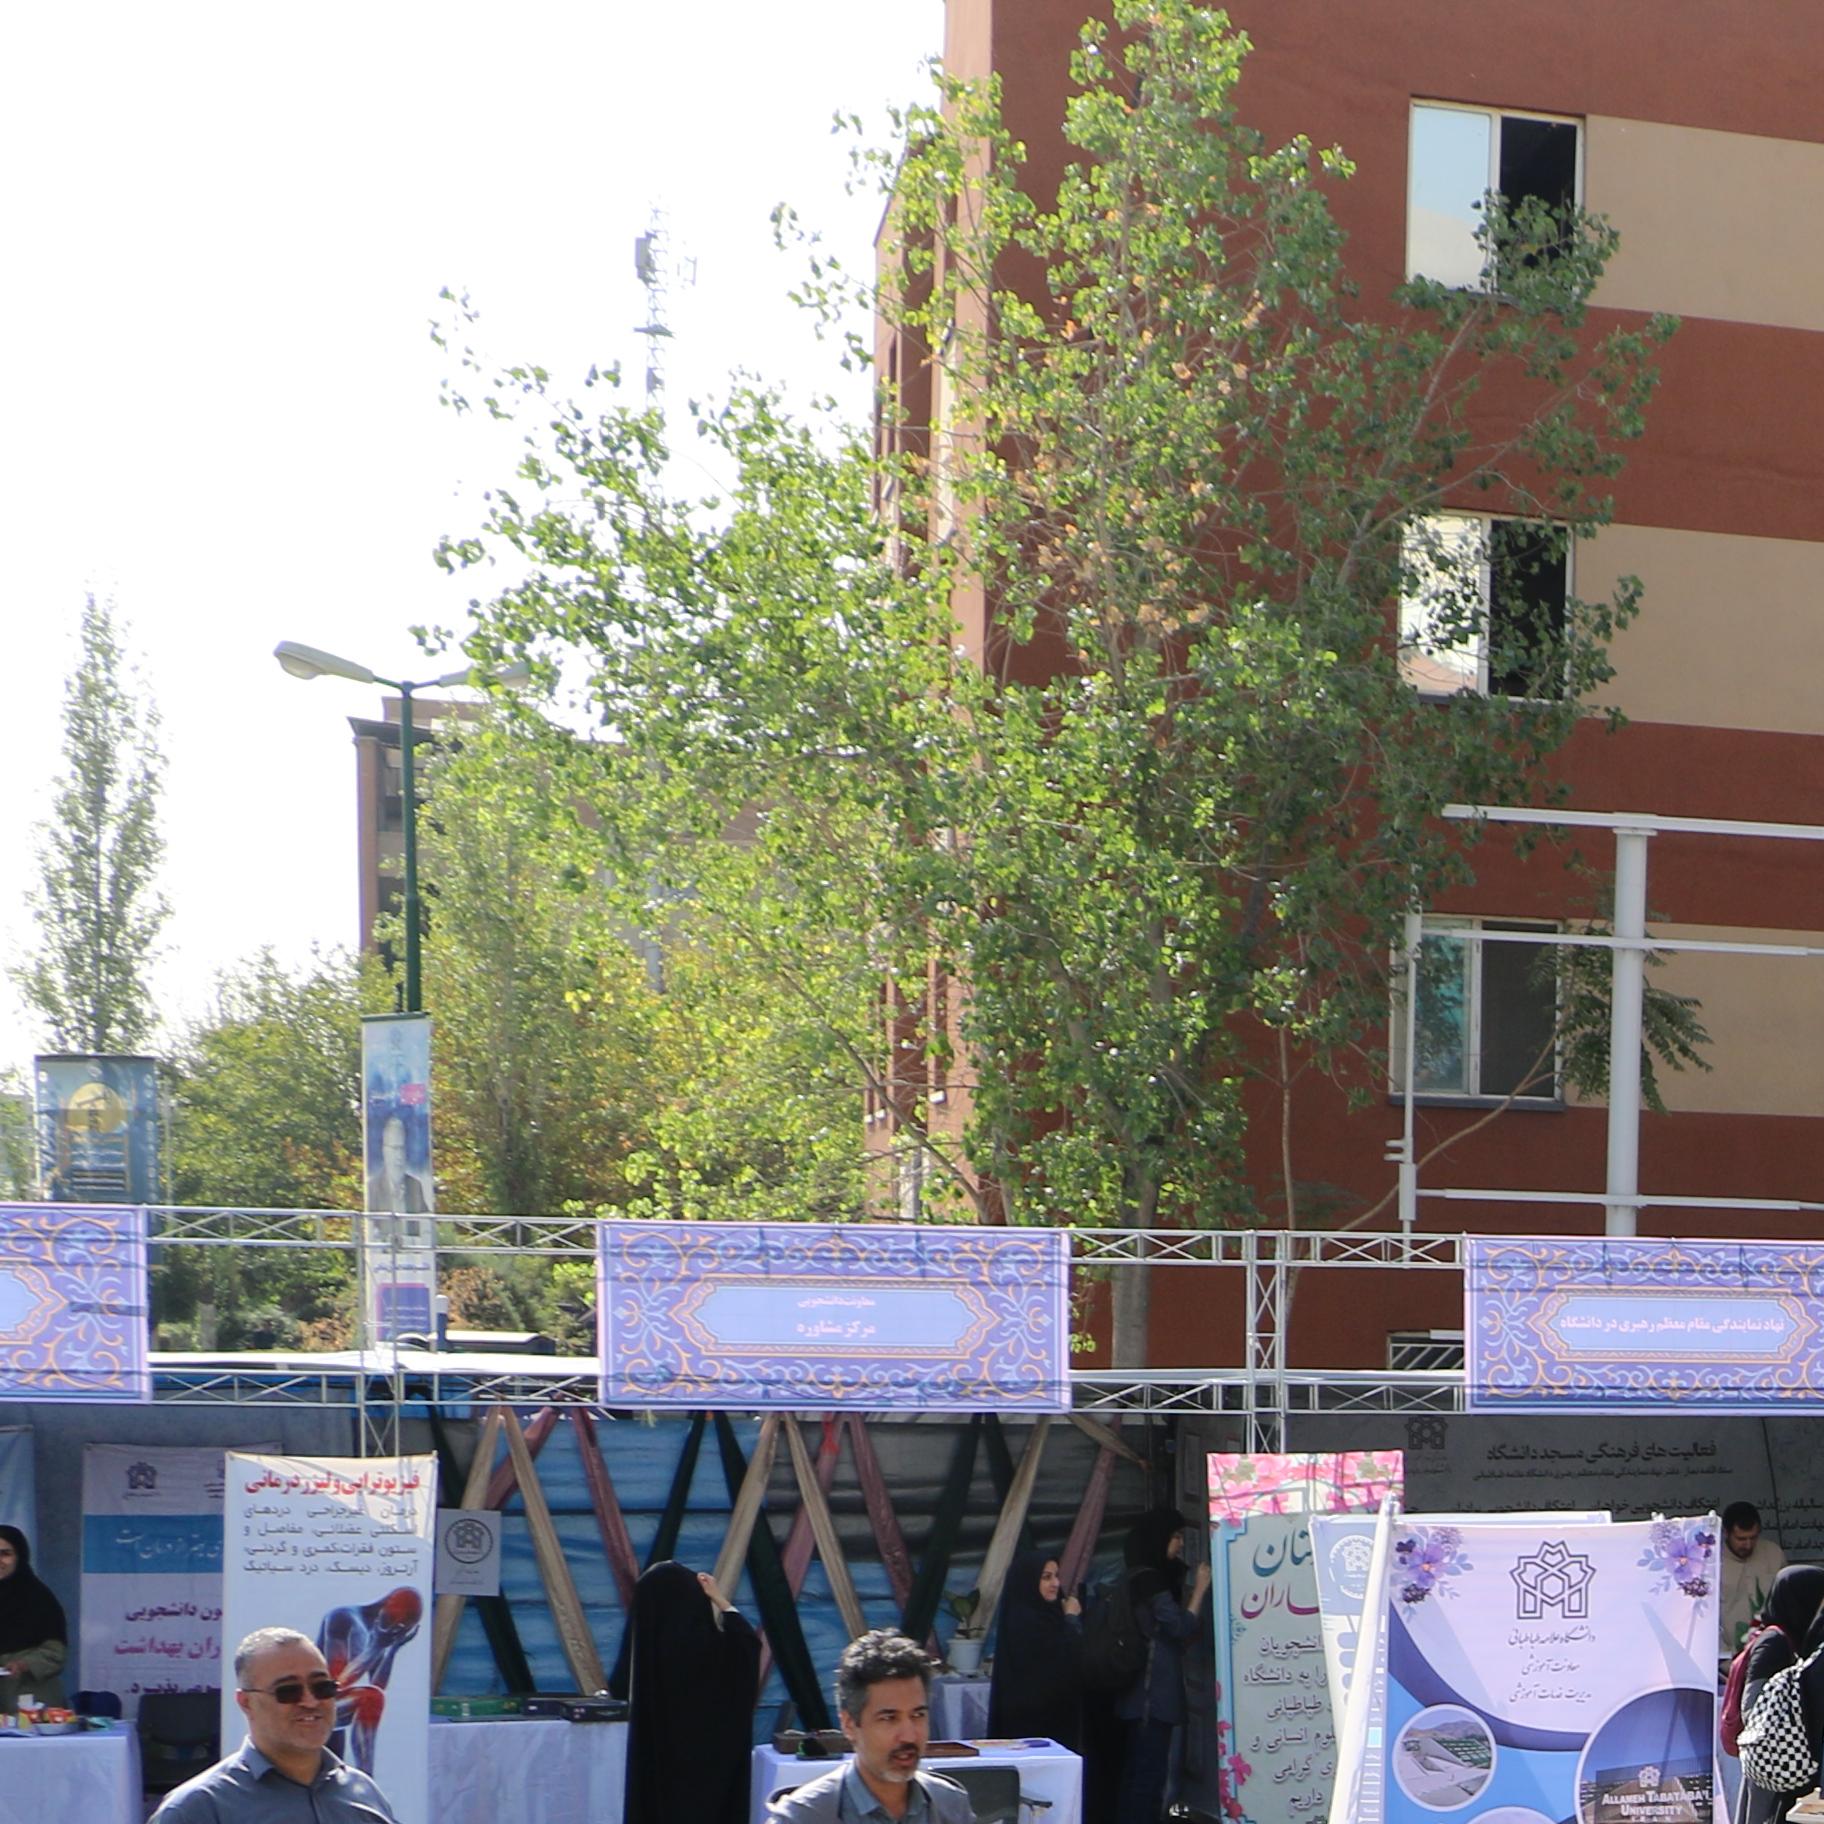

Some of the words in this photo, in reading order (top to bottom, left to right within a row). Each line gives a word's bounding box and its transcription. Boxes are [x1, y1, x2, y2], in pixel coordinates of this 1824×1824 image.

[796, 1319, 843, 1338] مشاوره
[844, 1320, 877, 1338] مرکز
[1559, 1315, 1603, 1330] دانشگاه
[1604, 1319, 1618, 1332] در
[1656, 1316, 1686, 1333] معظم
[1686, 1317, 1711, 1334] مقام
[1711, 1317, 1762, 1334] نمایندگی
[1763, 1318, 1786, 1333] نهاد
[244, 1469, 301, 1495] درمانی
[341, 1469, 420, 1496] فیزیوتراپی
[1260, 1634, 1324, 1658] انشجویان
[1243, 1666, 1293, 1687] دانشگاه
[1266, 1728, 1307, 1751] انسانی
